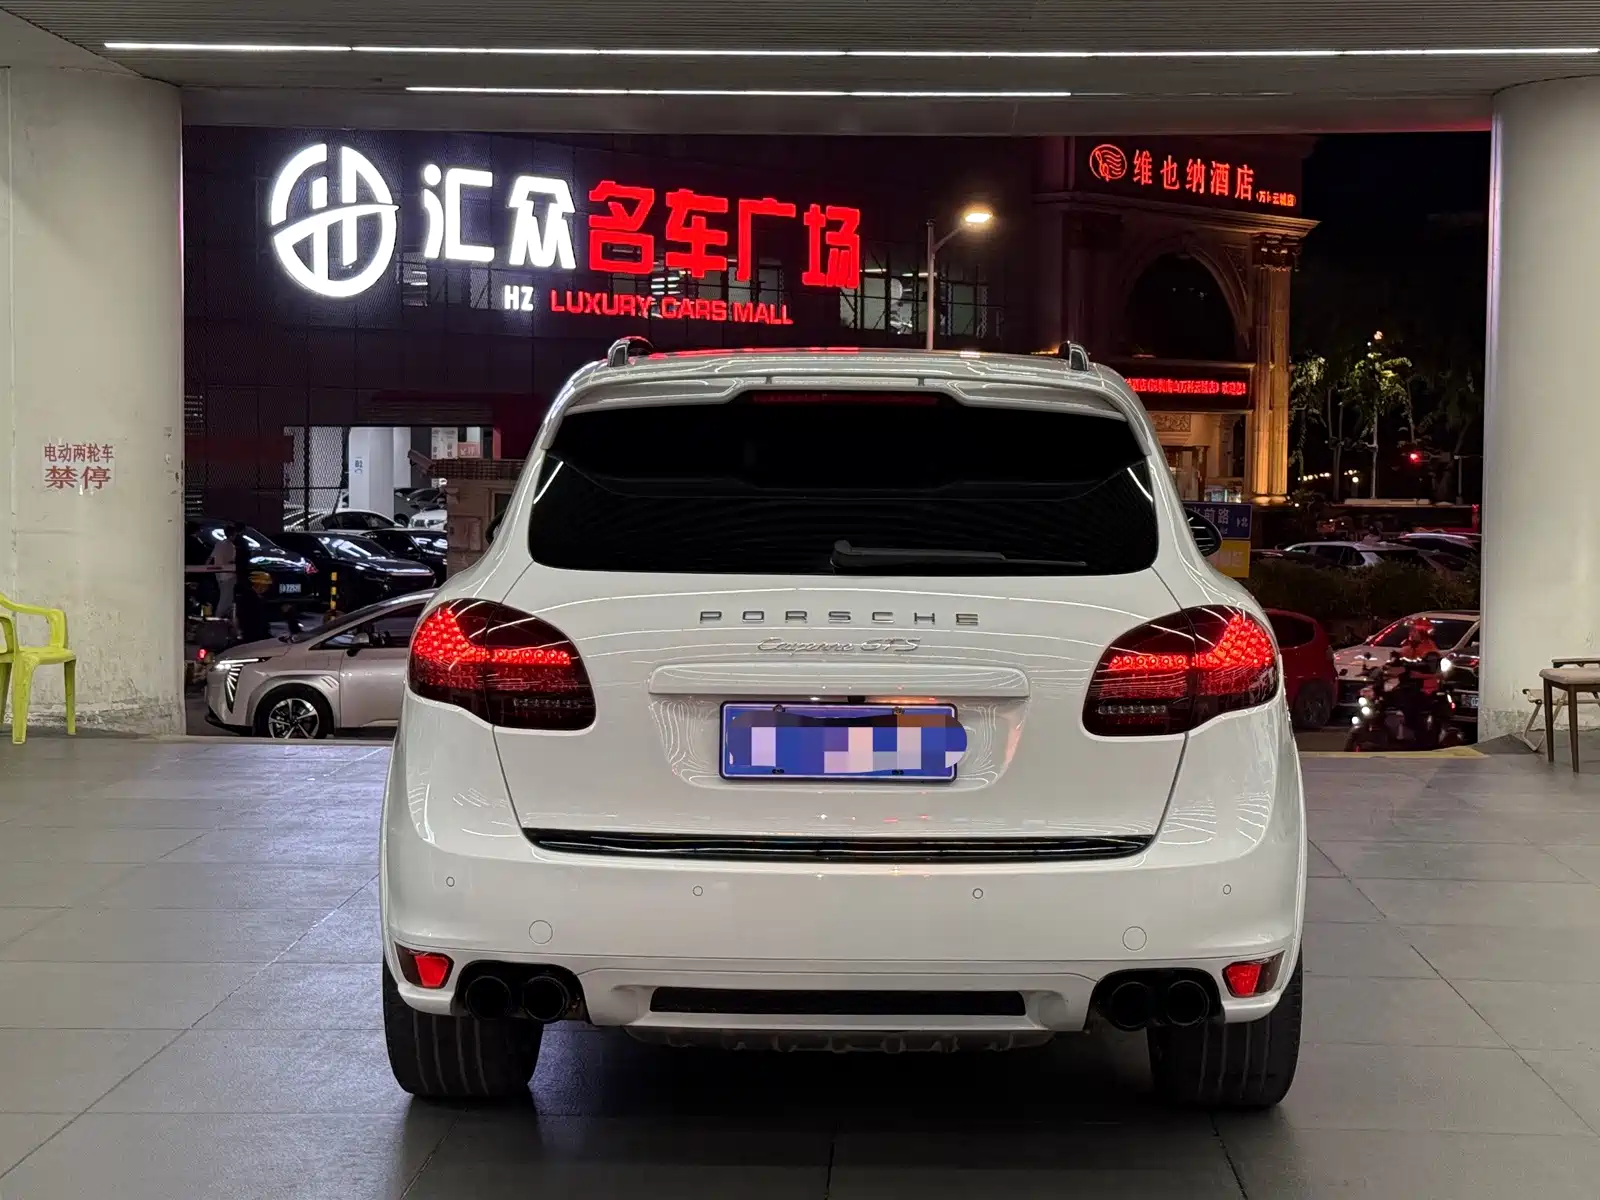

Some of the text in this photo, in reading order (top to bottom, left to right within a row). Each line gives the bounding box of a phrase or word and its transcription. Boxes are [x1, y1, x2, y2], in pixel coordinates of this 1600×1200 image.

[1133, 149, 1255, 201] 维也纳酒店
[421, 163, 861, 290] 汇众名车广场
[504, 285, 534, 311] HZ
[550, 289, 793, 325] LUXURY CARS MALL
[44, 443, 114, 463] 电动两轮车
[44, 465, 111, 490] 禁停
[700, 611, 979, 626] PORSCHE
[757, 637, 921, 655] Cayenne GTS
